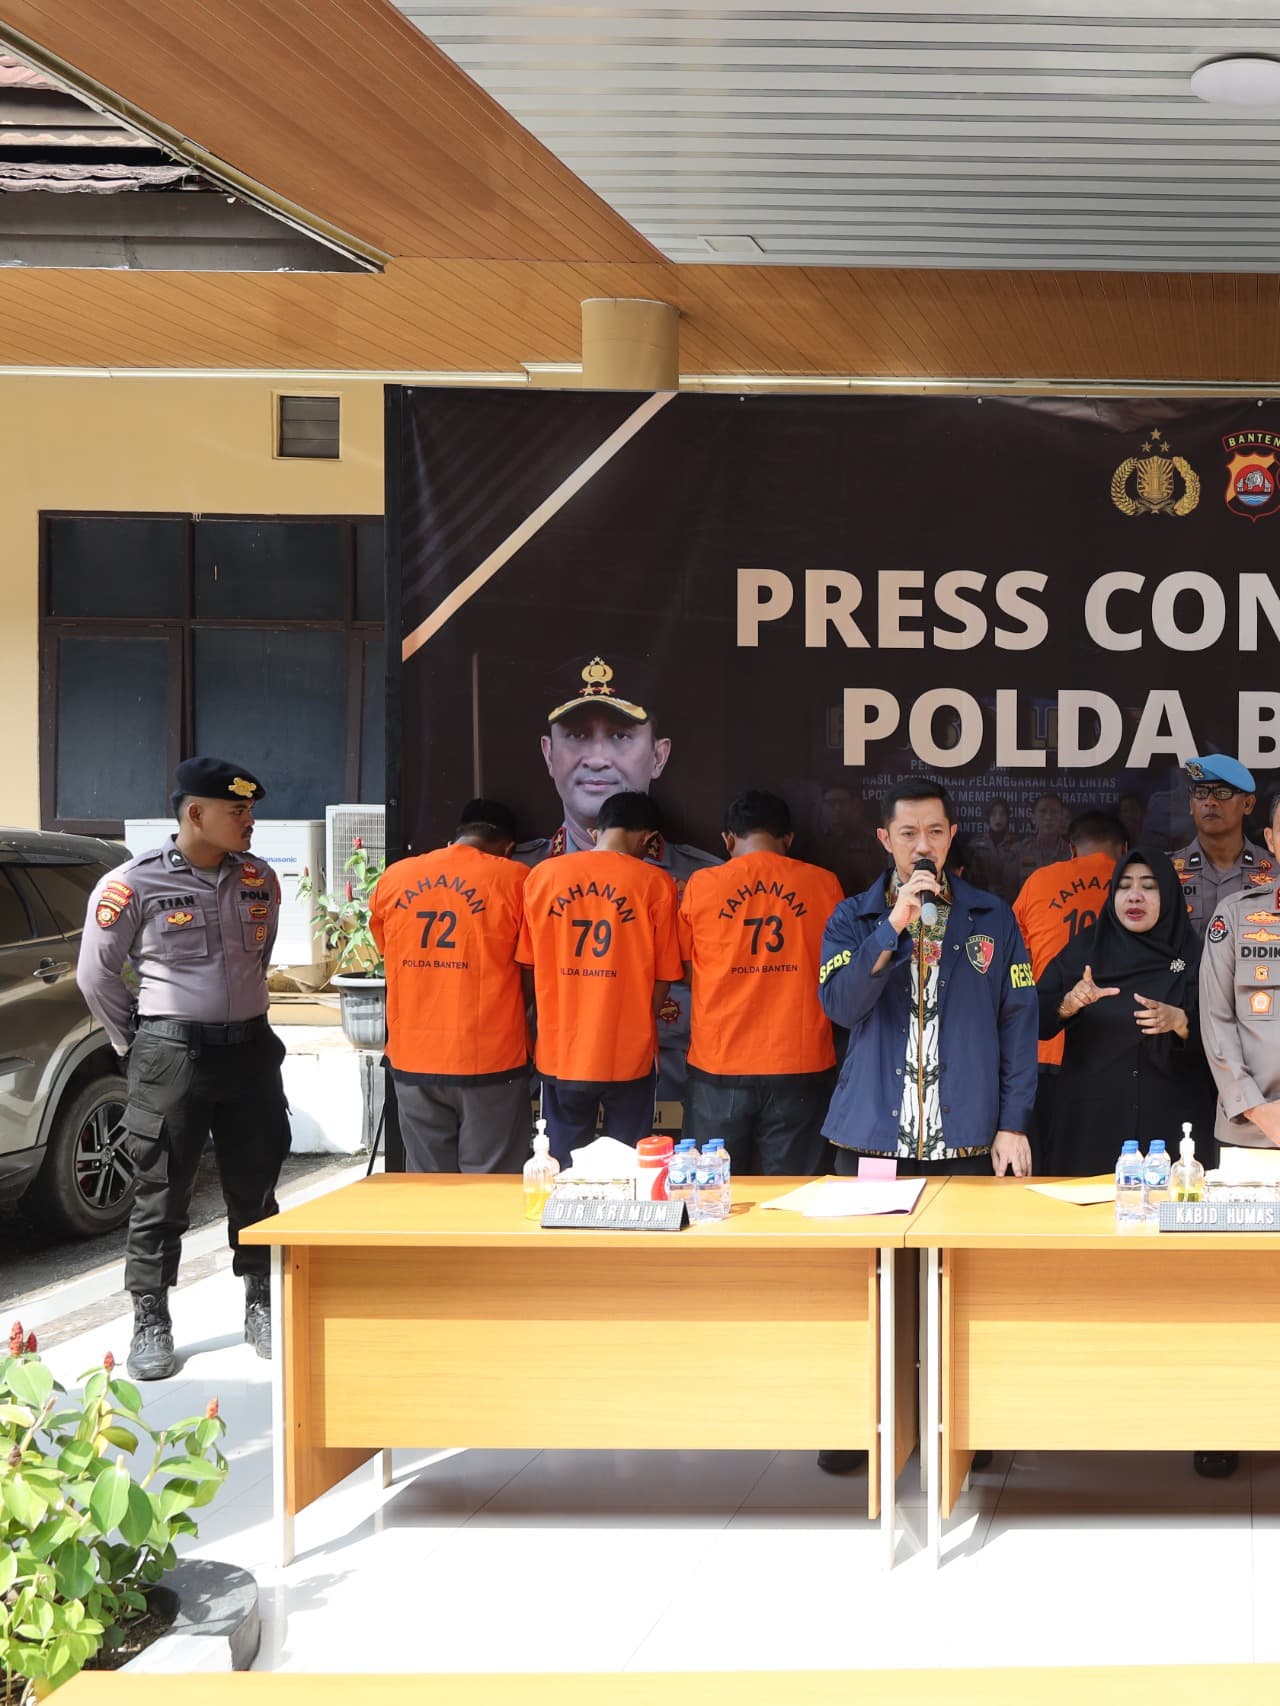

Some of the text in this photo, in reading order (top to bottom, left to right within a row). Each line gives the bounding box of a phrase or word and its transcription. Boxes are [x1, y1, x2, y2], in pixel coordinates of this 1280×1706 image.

[736, 568, 1049, 651] PRESS
[843, 687, 1201, 769] POLDA
[158, 895, 195, 909] TIAN
[395, 874, 487, 915] TAHANAN
[548, 880, 637, 925] TAHANAN
[718, 879, 808, 922] TAHANAN
[1048, 875, 1113, 910] TAHA
[416, 910, 457, 949] 72
[572, 918, 612, 958] 79
[743, 914, 785, 955] 73
[402, 959, 469, 970] POLDA BANTEN
[582, 968, 617, 978] BANTEN
[731, 963, 798, 975] POLDA BANTEN
[555, 1202, 668, 1223] DIR KRIMUM
[1176, 1207, 1274, 1225] KABID HUMAS
